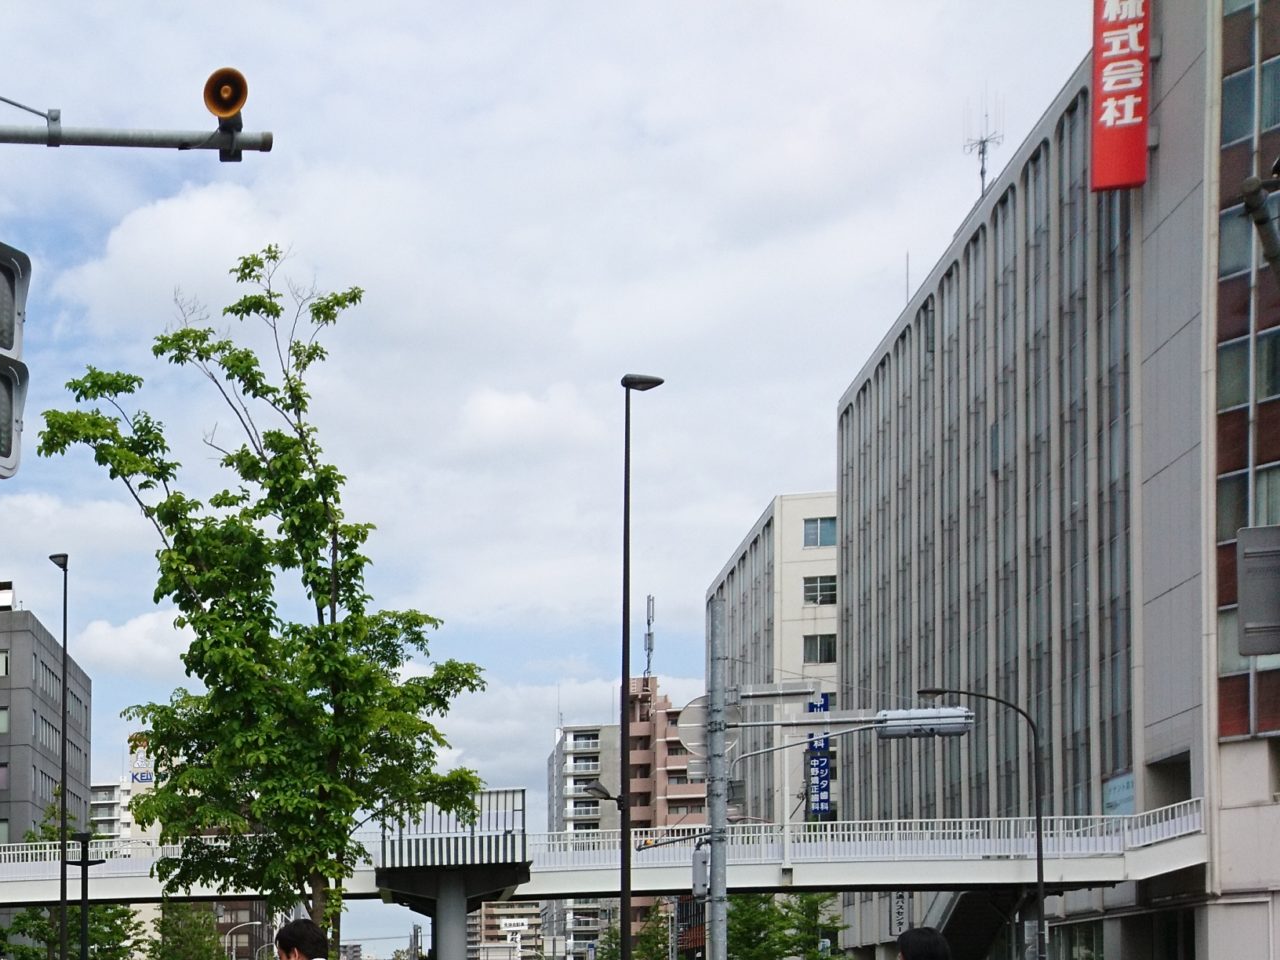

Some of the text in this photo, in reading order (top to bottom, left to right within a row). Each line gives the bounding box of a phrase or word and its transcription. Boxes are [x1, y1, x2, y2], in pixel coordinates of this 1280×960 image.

[895, 890, 905, 933] 通バスセンター
